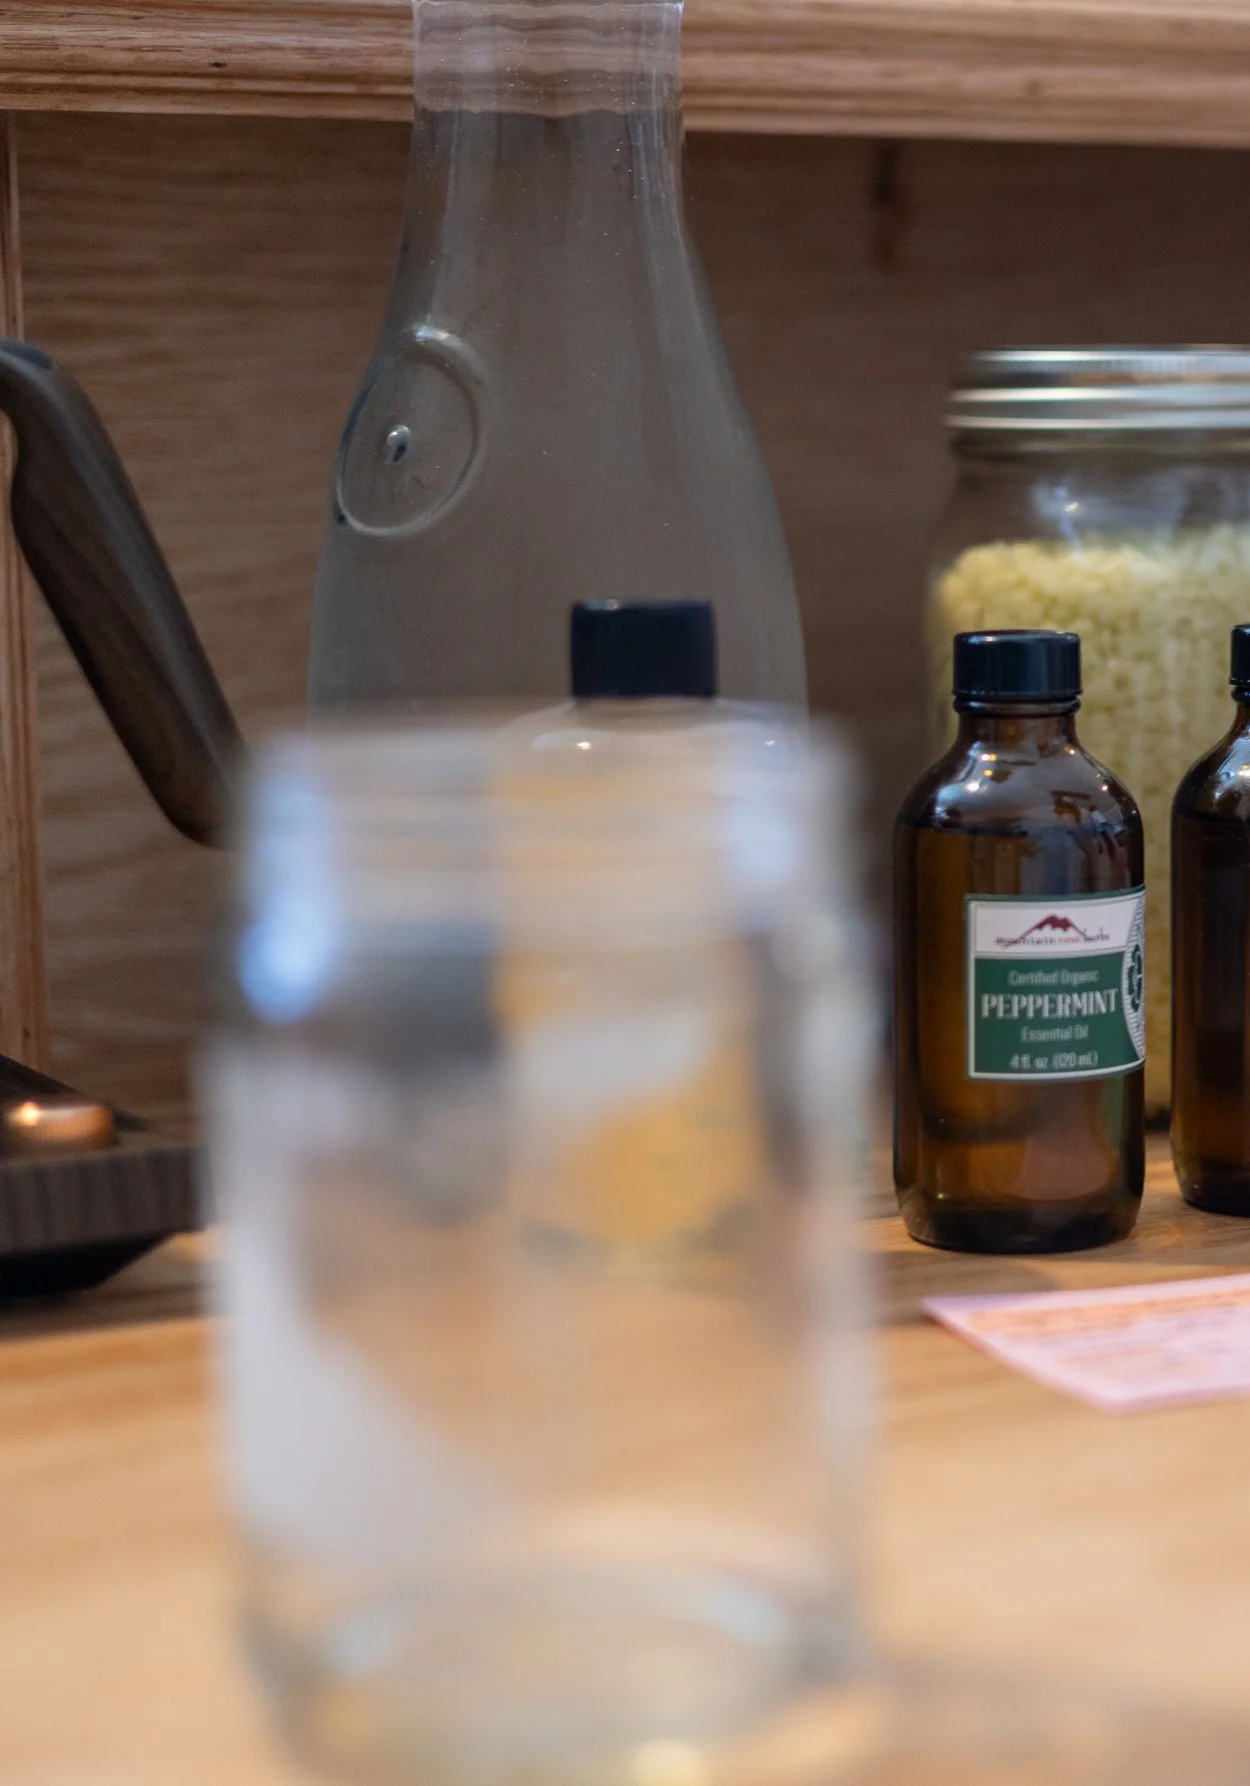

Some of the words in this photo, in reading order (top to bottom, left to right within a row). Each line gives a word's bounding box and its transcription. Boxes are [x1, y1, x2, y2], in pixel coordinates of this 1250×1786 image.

[1008, 971, 1058, 985] Certified
[1060, 970, 1099, 985] Organic
[981, 989, 1118, 1019] PEPPERMINT
[1022, 1026, 1073, 1042] Essential
[1076, 1025, 1088, 1039] Oil
[1010, 1055, 1019, 1068] 4
